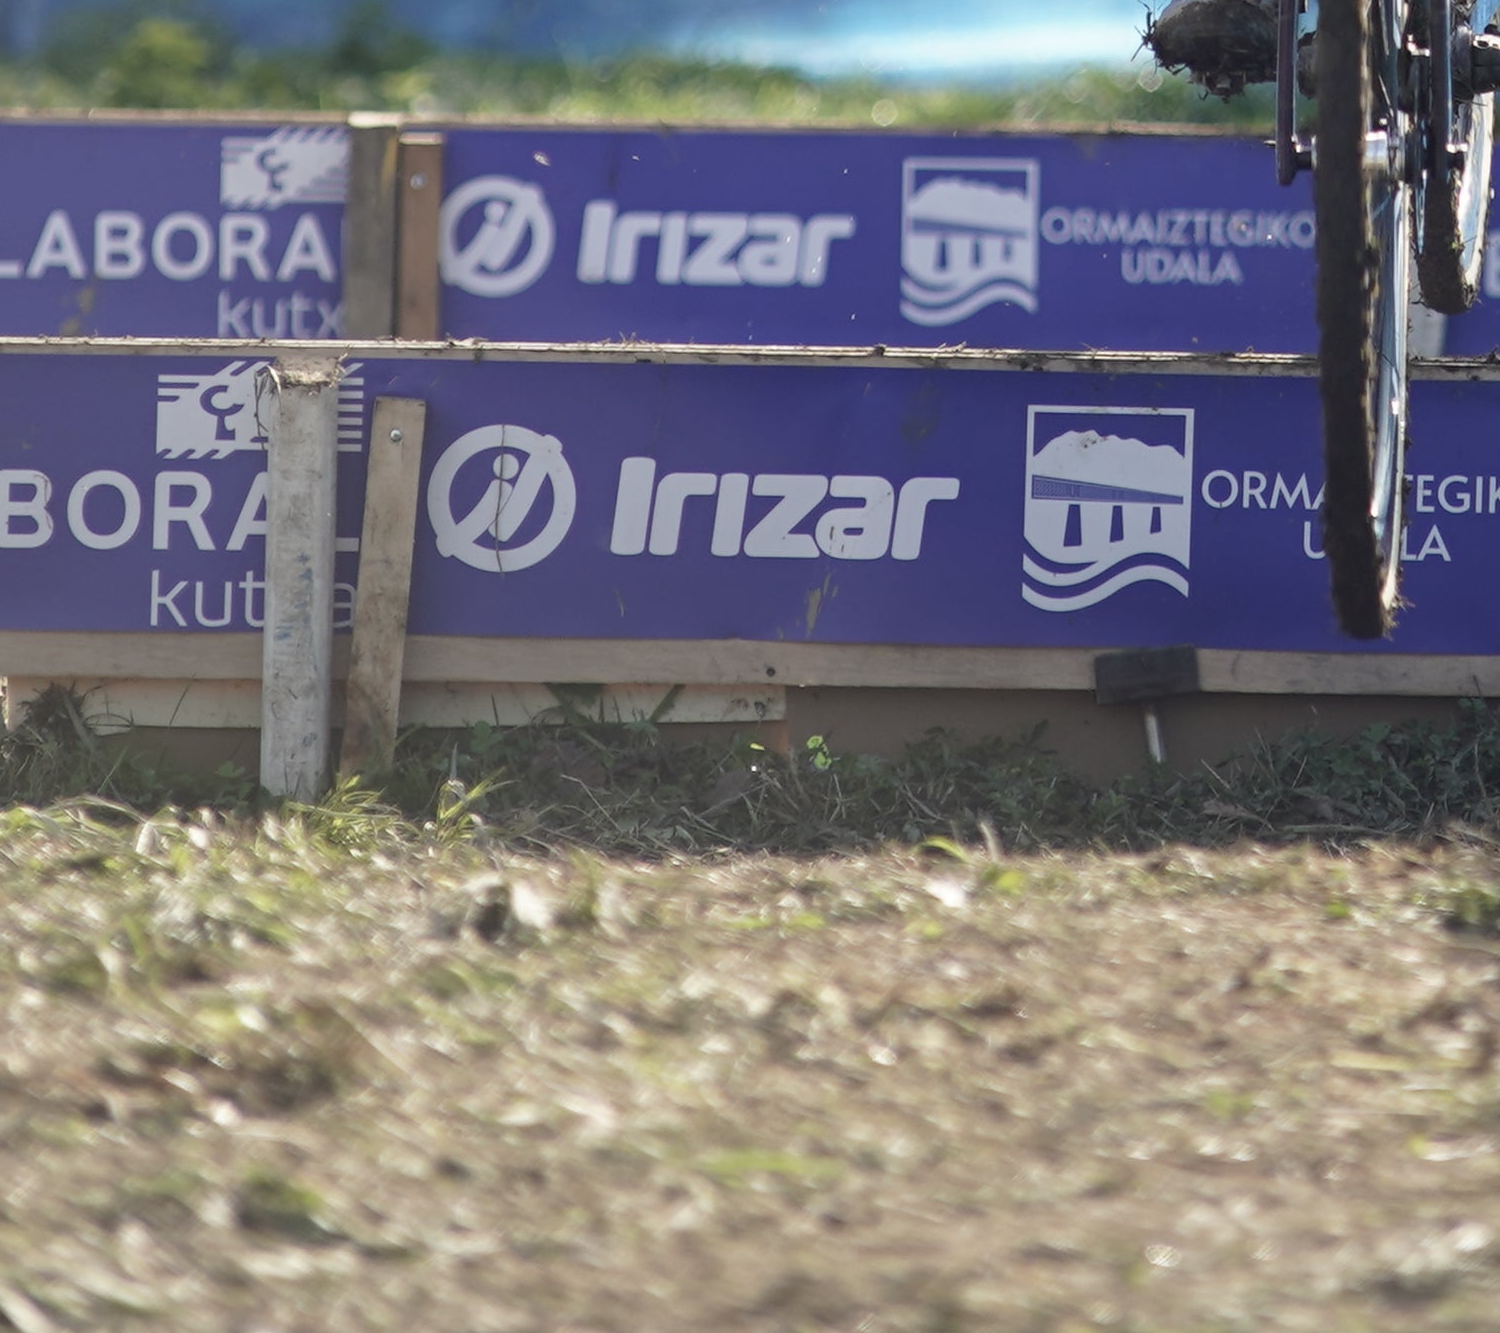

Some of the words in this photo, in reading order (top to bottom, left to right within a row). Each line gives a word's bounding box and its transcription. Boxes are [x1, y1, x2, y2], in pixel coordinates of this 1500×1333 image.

[577, 200, 854, 286] Irizar
[1039, 205, 1316, 250] ORMAIZTEGIKO
[1120, 247, 1243, 285] UDALA
[216, 289, 347, 337] kutx
[609, 456, 961, 561] Irizar
[1302, 520, 1452, 563] ULA
[150, 568, 358, 629] kuta
